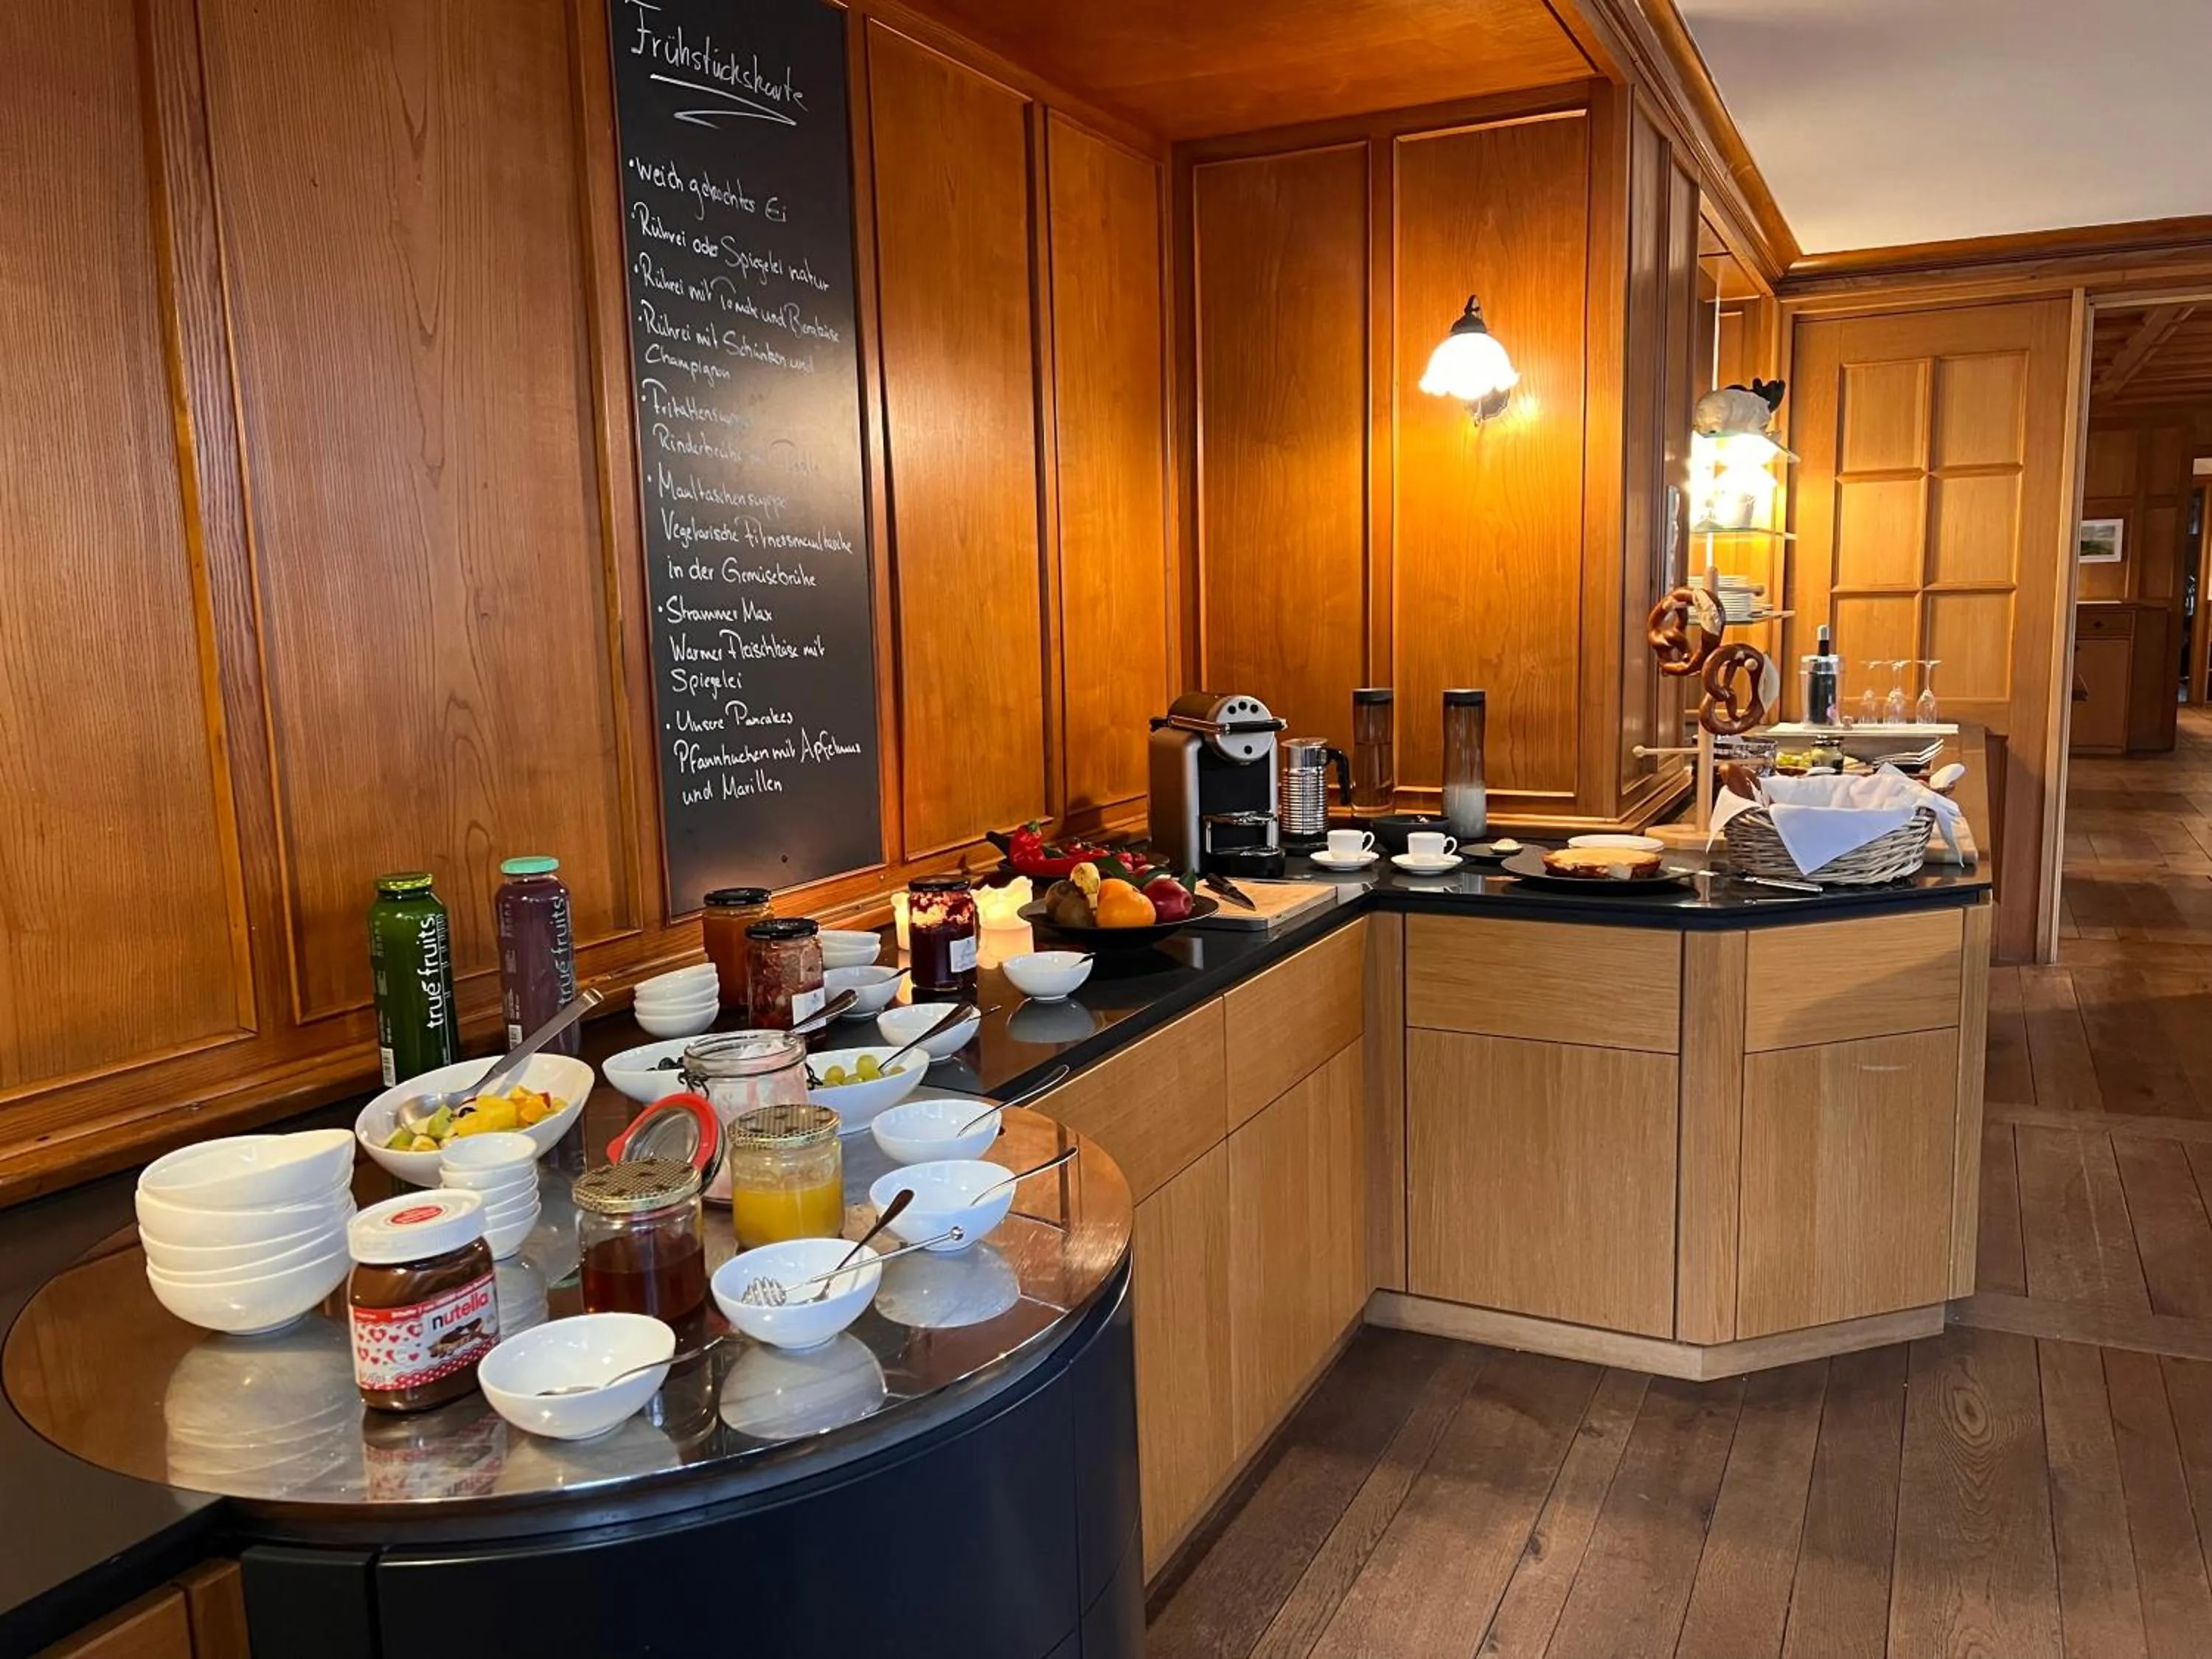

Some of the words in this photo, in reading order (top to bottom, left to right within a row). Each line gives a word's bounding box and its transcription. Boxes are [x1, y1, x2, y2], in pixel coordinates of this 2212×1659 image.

[625, 0, 809, 111] Frühstückskarte
[765, 197, 787, 221] Ei
[633, 201, 686, 246] Rührei
[692, 236, 719, 257] oder
[789, 258, 830, 291] natur
[639, 252, 684, 295] Rührei
[689, 277, 712, 301] mit
[761, 307, 787, 328] und
[641, 299, 691, 341] Rührei
[696, 321, 717, 349] mit
[645, 343, 731, 389] Champignon
[658, 462, 787, 520] Maultaschensuppe
[661, 507, 740, 548] Vegetarische
[667, 555, 684, 580] in
[689, 558, 714, 581] der
[722, 557, 817, 586] Gemüsebrühe
[667, 594, 737, 624] Strammer
[741, 597, 773, 624] Max
[669, 632, 723, 661] Warmer
[803, 635, 825, 658] mit
[671, 667, 742, 700] Spiegelei
[676, 710, 725, 733] Unsere
[725, 700, 794, 726] Pancakes
[674, 739, 769, 774] Pfannkuchen
[773, 739, 796, 760] mit
[682, 779, 713, 806] und
[722, 770, 782, 800] Marillen
[416, 916, 439, 977] fruits
[550, 896, 568, 956] fruits
[421, 976, 445, 1029] true
[554, 959, 574, 1005] true
[432, 1291, 489, 1329] nutella
